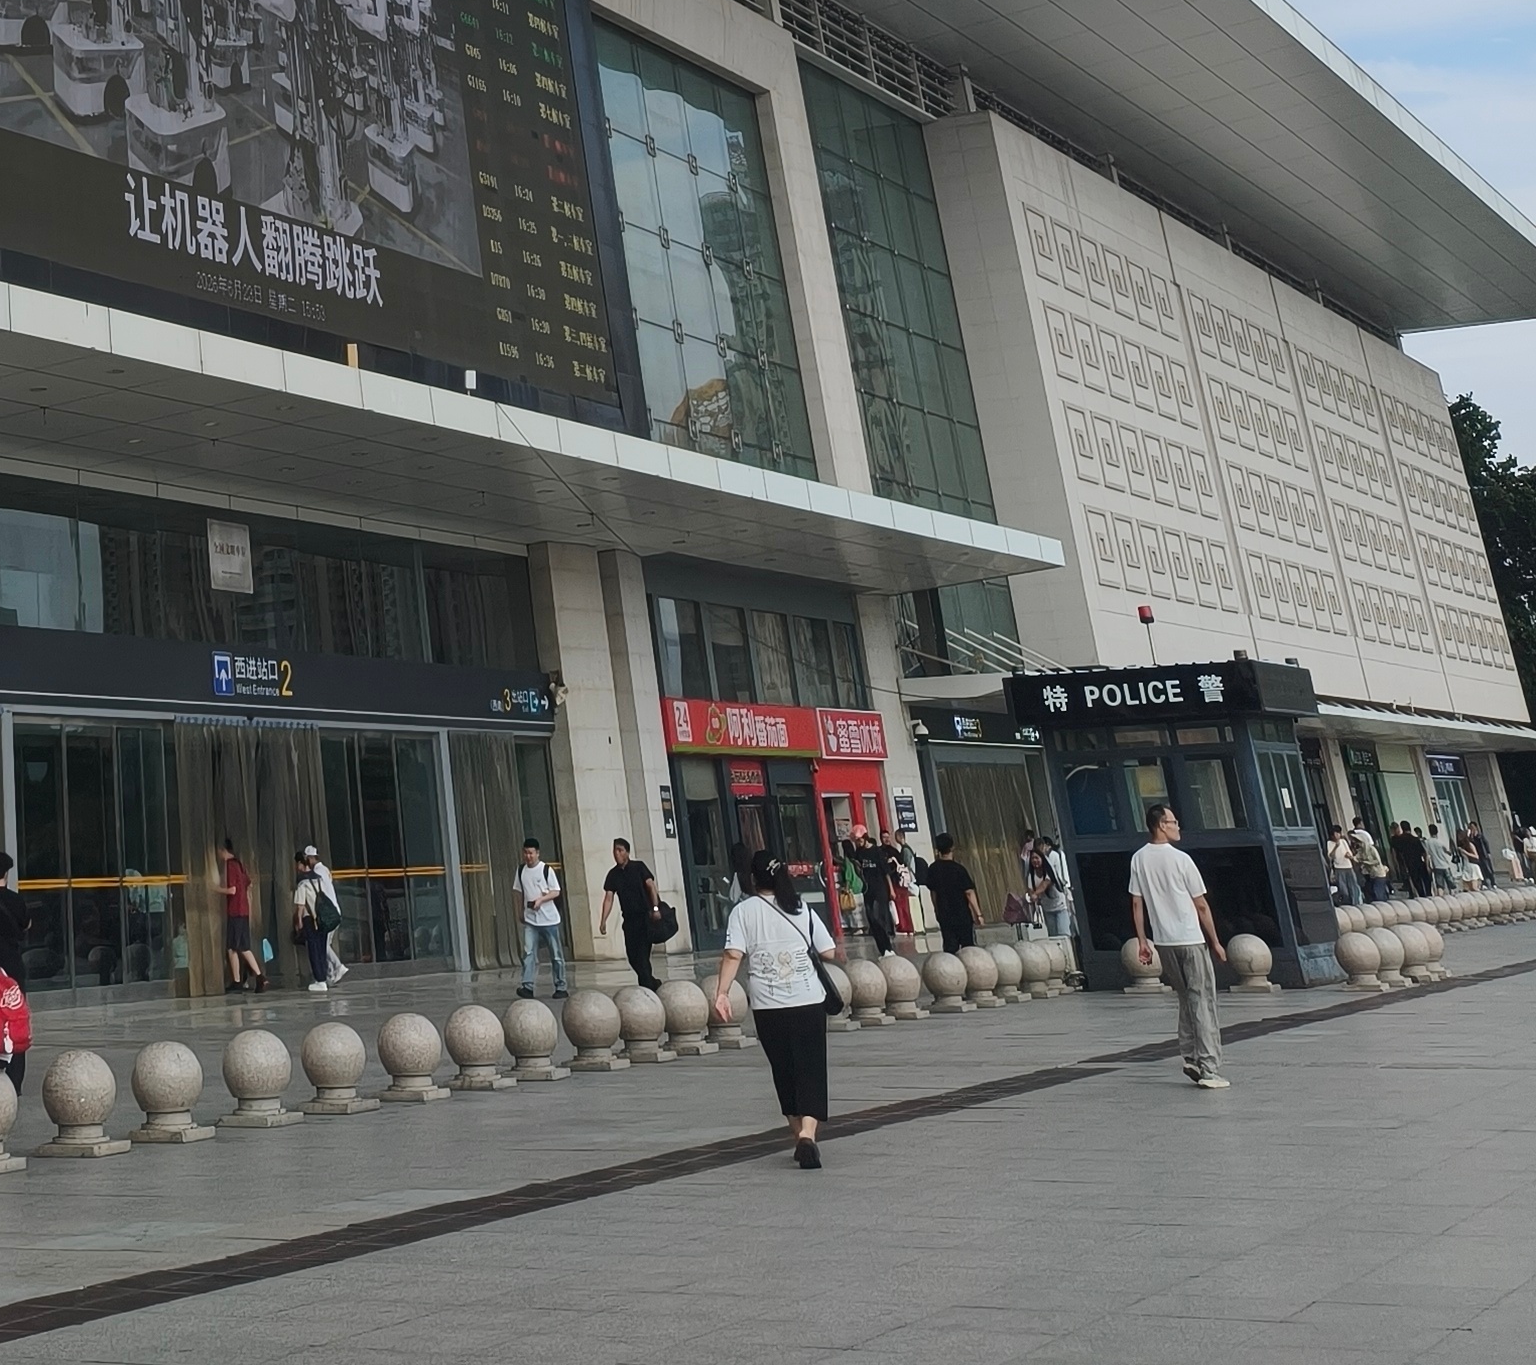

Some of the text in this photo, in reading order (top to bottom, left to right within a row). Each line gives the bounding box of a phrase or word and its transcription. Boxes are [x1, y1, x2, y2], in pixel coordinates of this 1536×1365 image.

[514, 184, 533, 202] 16:24
[125, 173, 383, 307] 让机器人翻腾跳跃
[268, 288, 296, 313] 星期二
[234, 656, 293, 697] 西进站口 2
[236, 684, 280, 697] West Entrance
[503, 688, 512, 712] 3
[1042, 674, 1225, 713] 特 POLICE 警
[675, 706, 689, 728] 24
[836, 718, 884, 754] 蜜雪冰城
